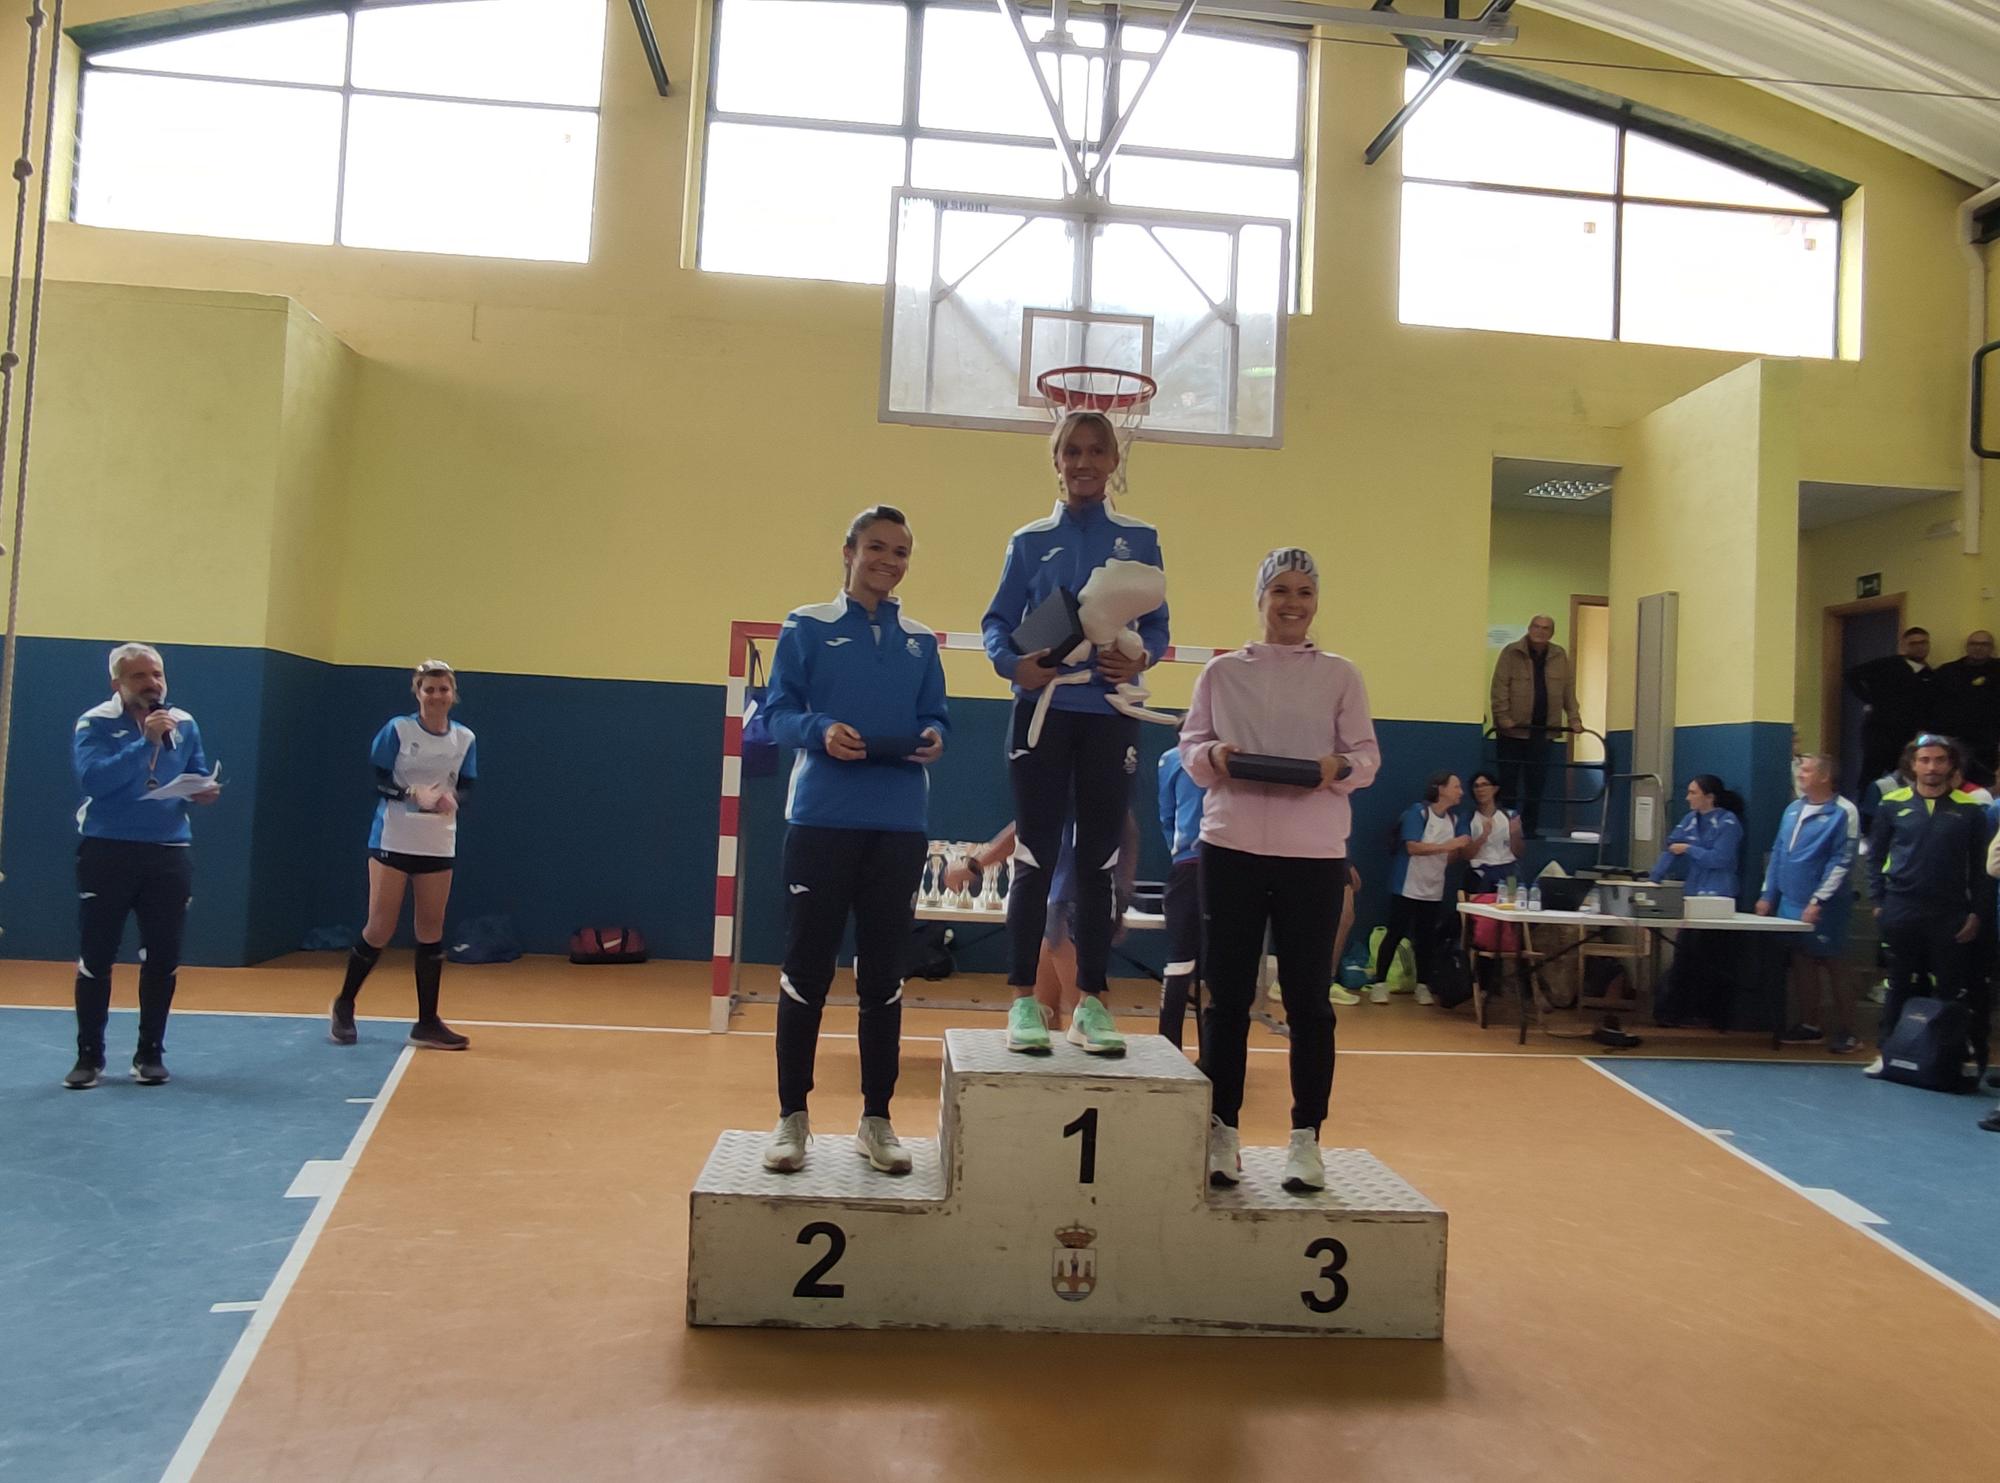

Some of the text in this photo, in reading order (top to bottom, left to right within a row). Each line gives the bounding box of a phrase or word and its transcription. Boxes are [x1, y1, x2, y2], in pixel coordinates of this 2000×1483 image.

[1063, 1107, 1099, 1185] 1
[791, 1221, 847, 1300] 2
[1299, 1237, 1350, 1314] 3
